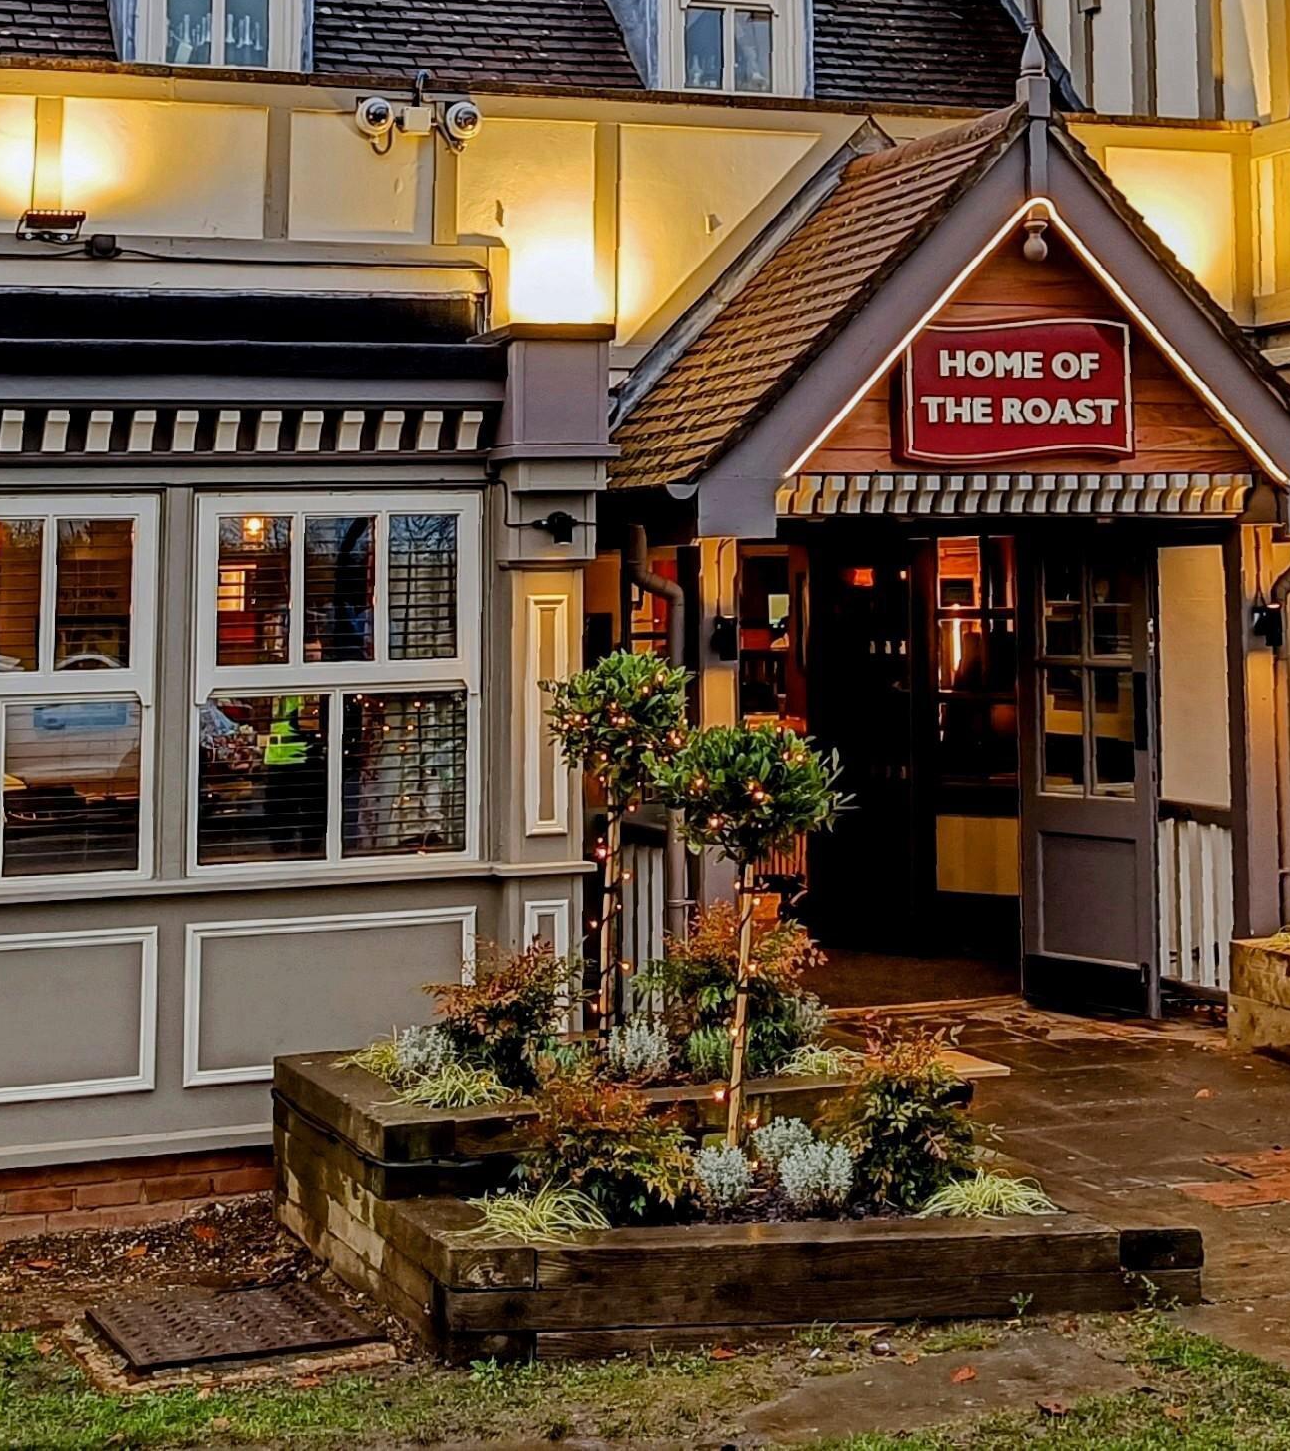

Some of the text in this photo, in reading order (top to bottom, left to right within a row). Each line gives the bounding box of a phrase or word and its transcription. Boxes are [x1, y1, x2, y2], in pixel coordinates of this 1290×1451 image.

[938, 349, 1100, 380] HOME OF
[920, 396, 1119, 425] THE ROAST
